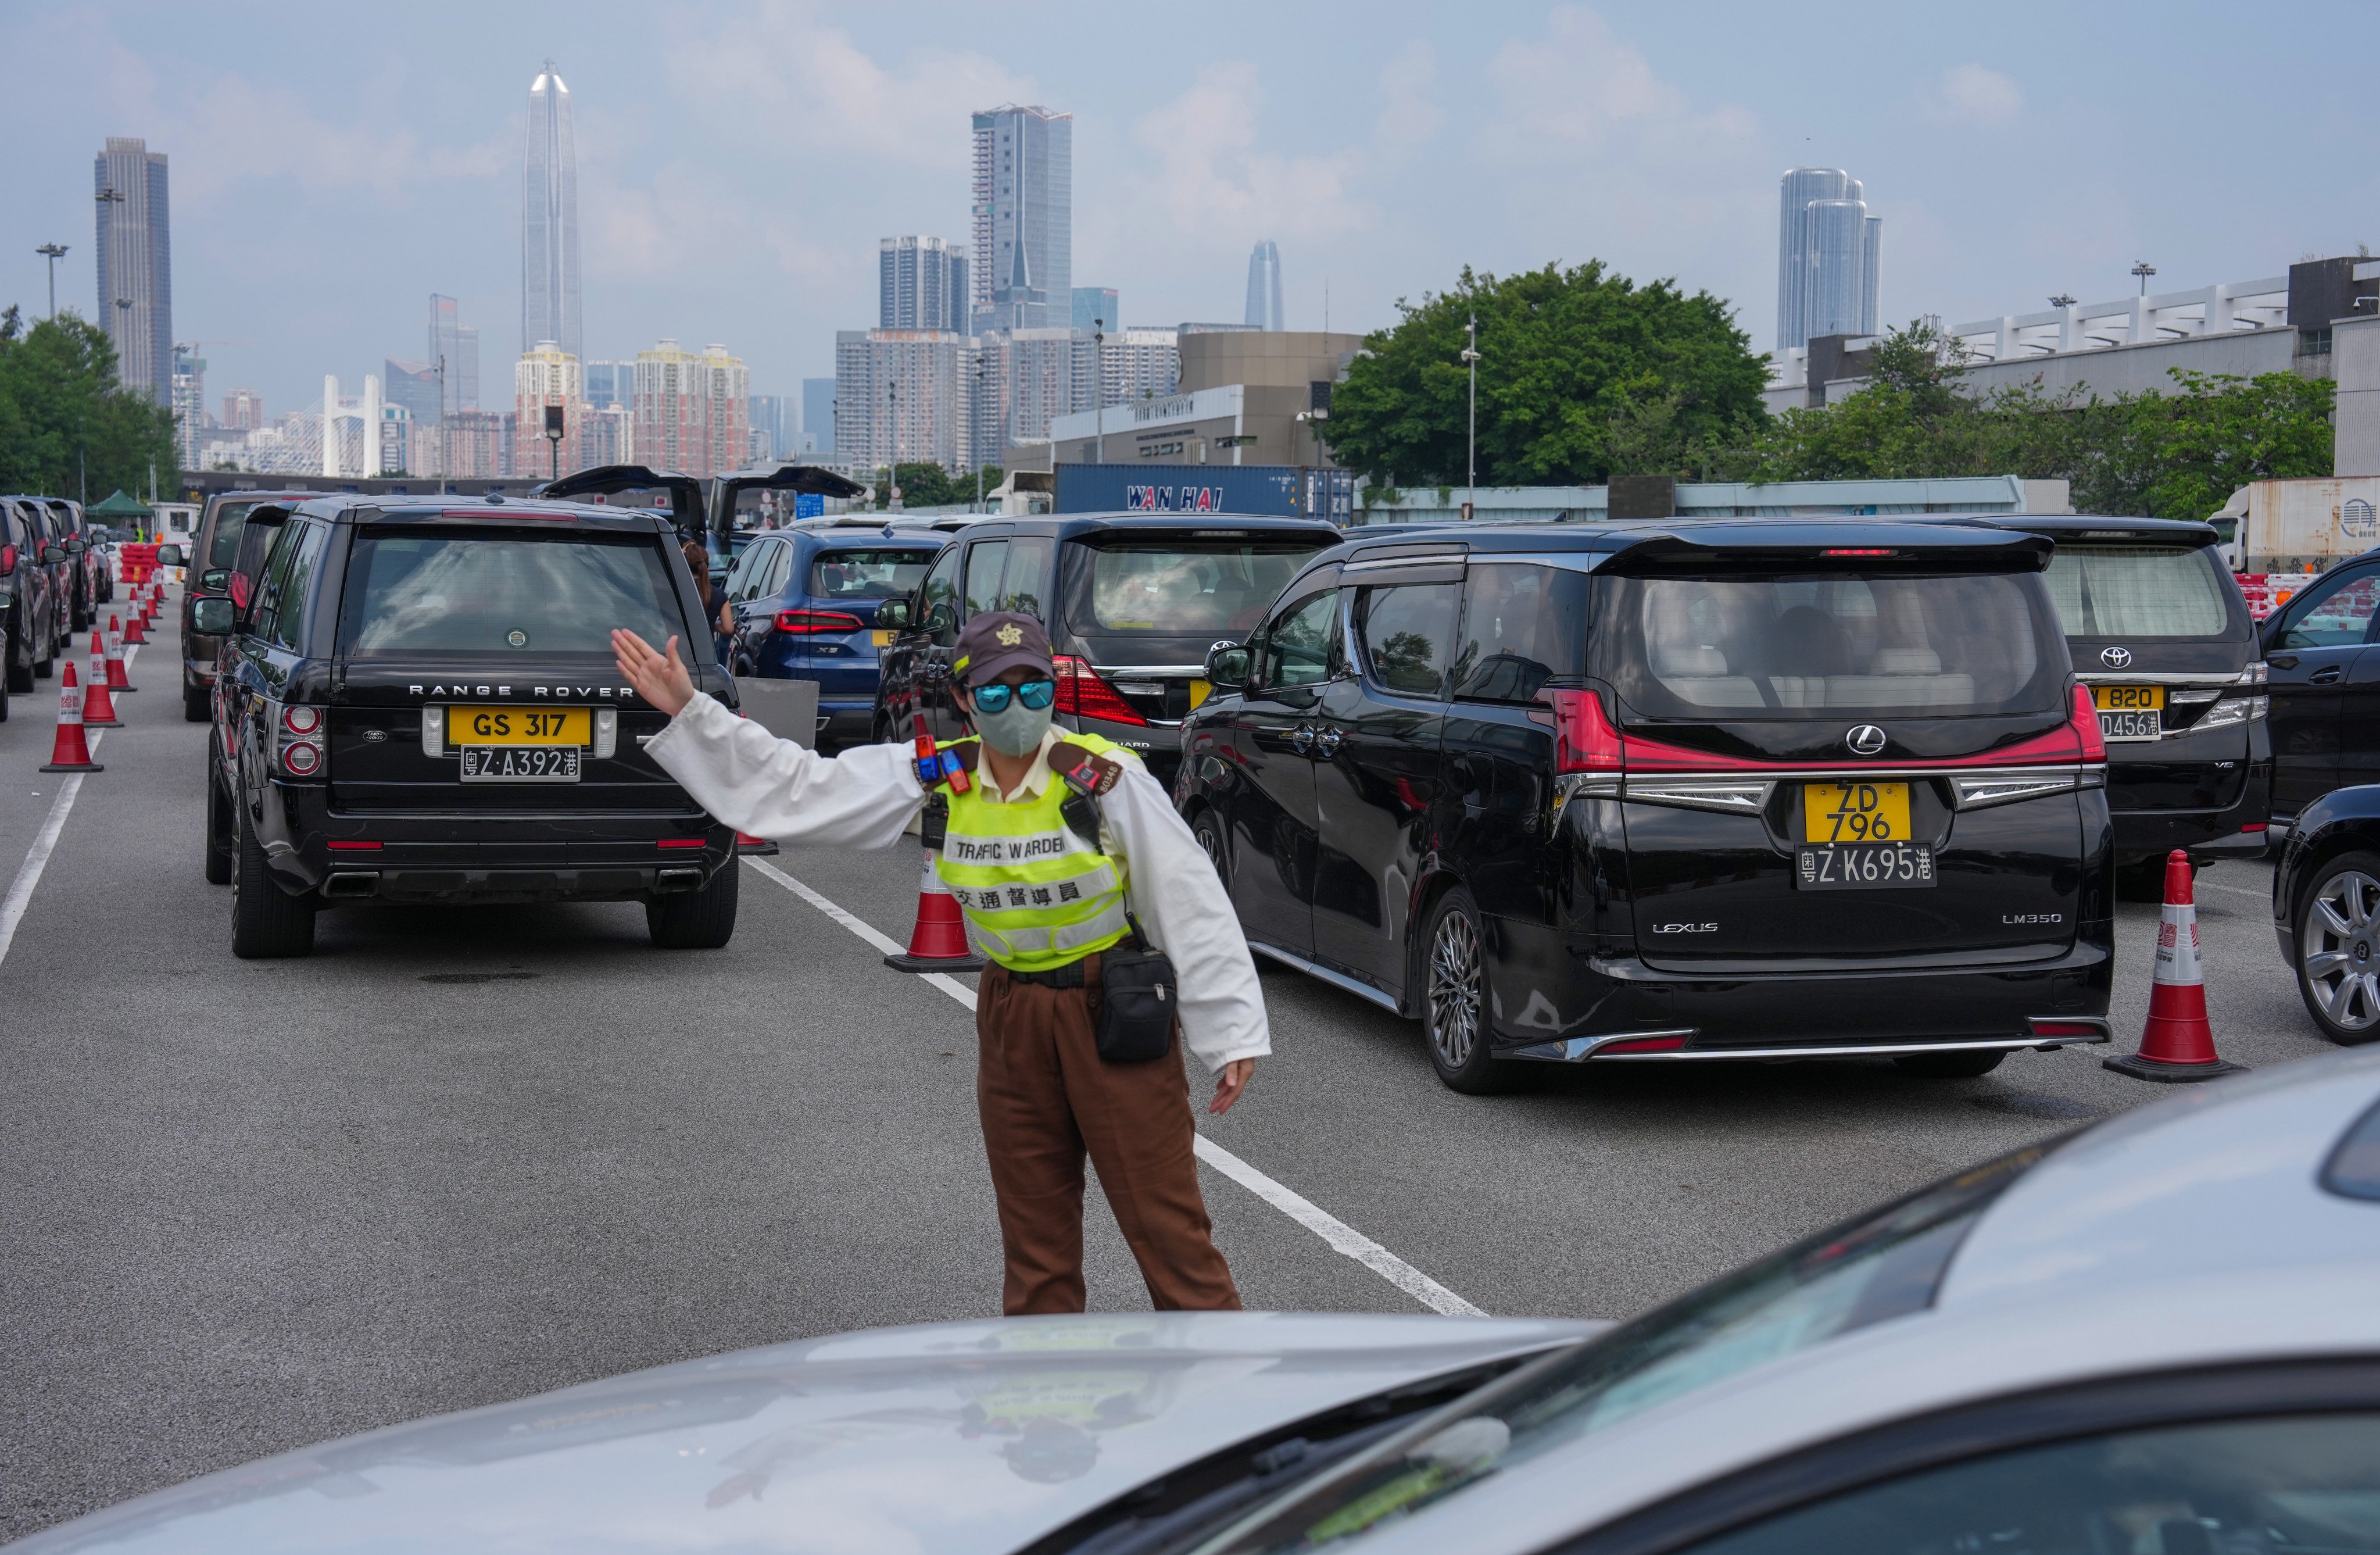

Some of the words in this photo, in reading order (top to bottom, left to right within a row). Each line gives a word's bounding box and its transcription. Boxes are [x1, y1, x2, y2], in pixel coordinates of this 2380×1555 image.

[1128, 485, 1173, 511] WAN
[1180, 487, 1223, 512] HAI
[409, 685, 511, 696] RANGE
[534, 687, 634, 697] ROVER
[2110, 688, 2152, 707] 820
[474, 714, 510, 737] GS
[525, 714, 567, 737] 317
[1100, 766, 1118, 792] 80348
[1837, 784, 1879, 813] ZD
[1826, 812, 1891, 841] 796
[955, 881, 1081, 910] 交通督導員
[1653, 923, 1718, 933] LEXUS
[2002, 914, 2062, 924] LM350
